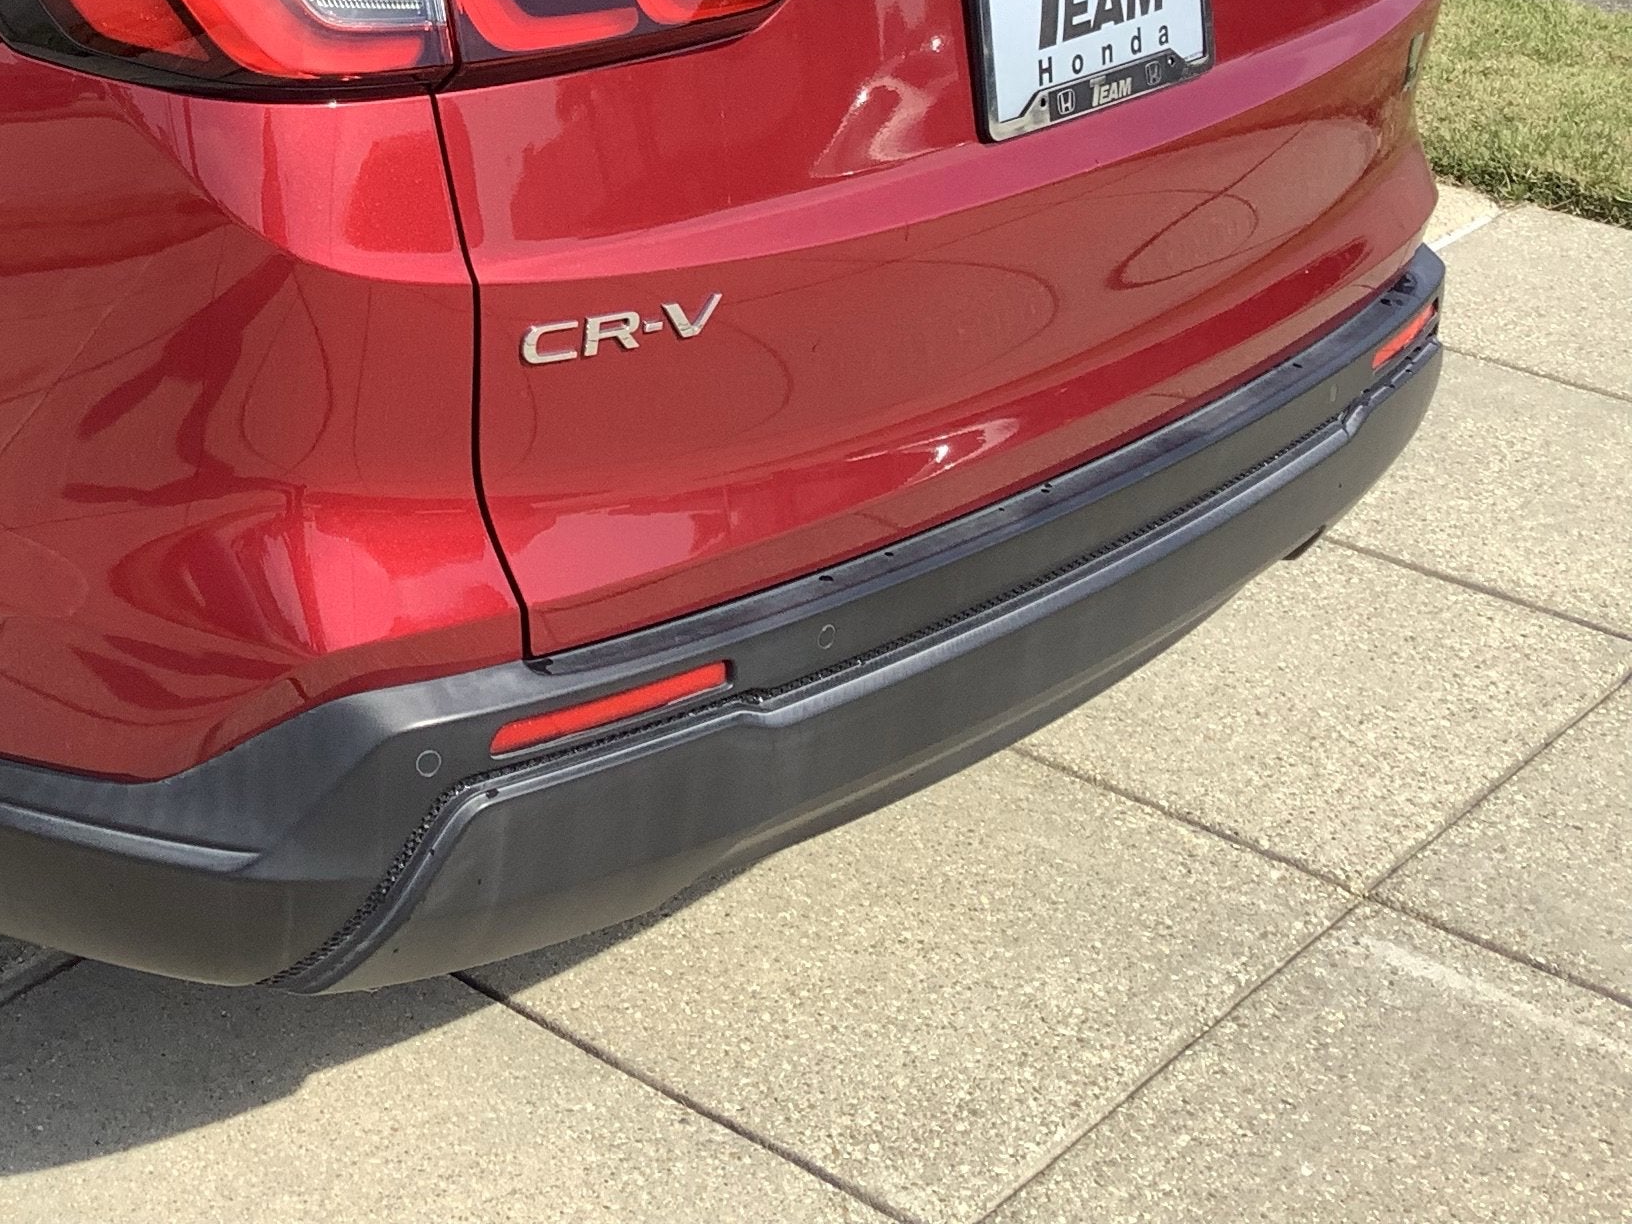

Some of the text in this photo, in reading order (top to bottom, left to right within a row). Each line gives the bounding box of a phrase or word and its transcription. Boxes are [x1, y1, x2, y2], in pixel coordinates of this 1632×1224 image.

[1038, 24, 1170, 87] Honda
[1089, 75, 1133, 108] TEAM
[522, 292, 723, 365] CR-V
